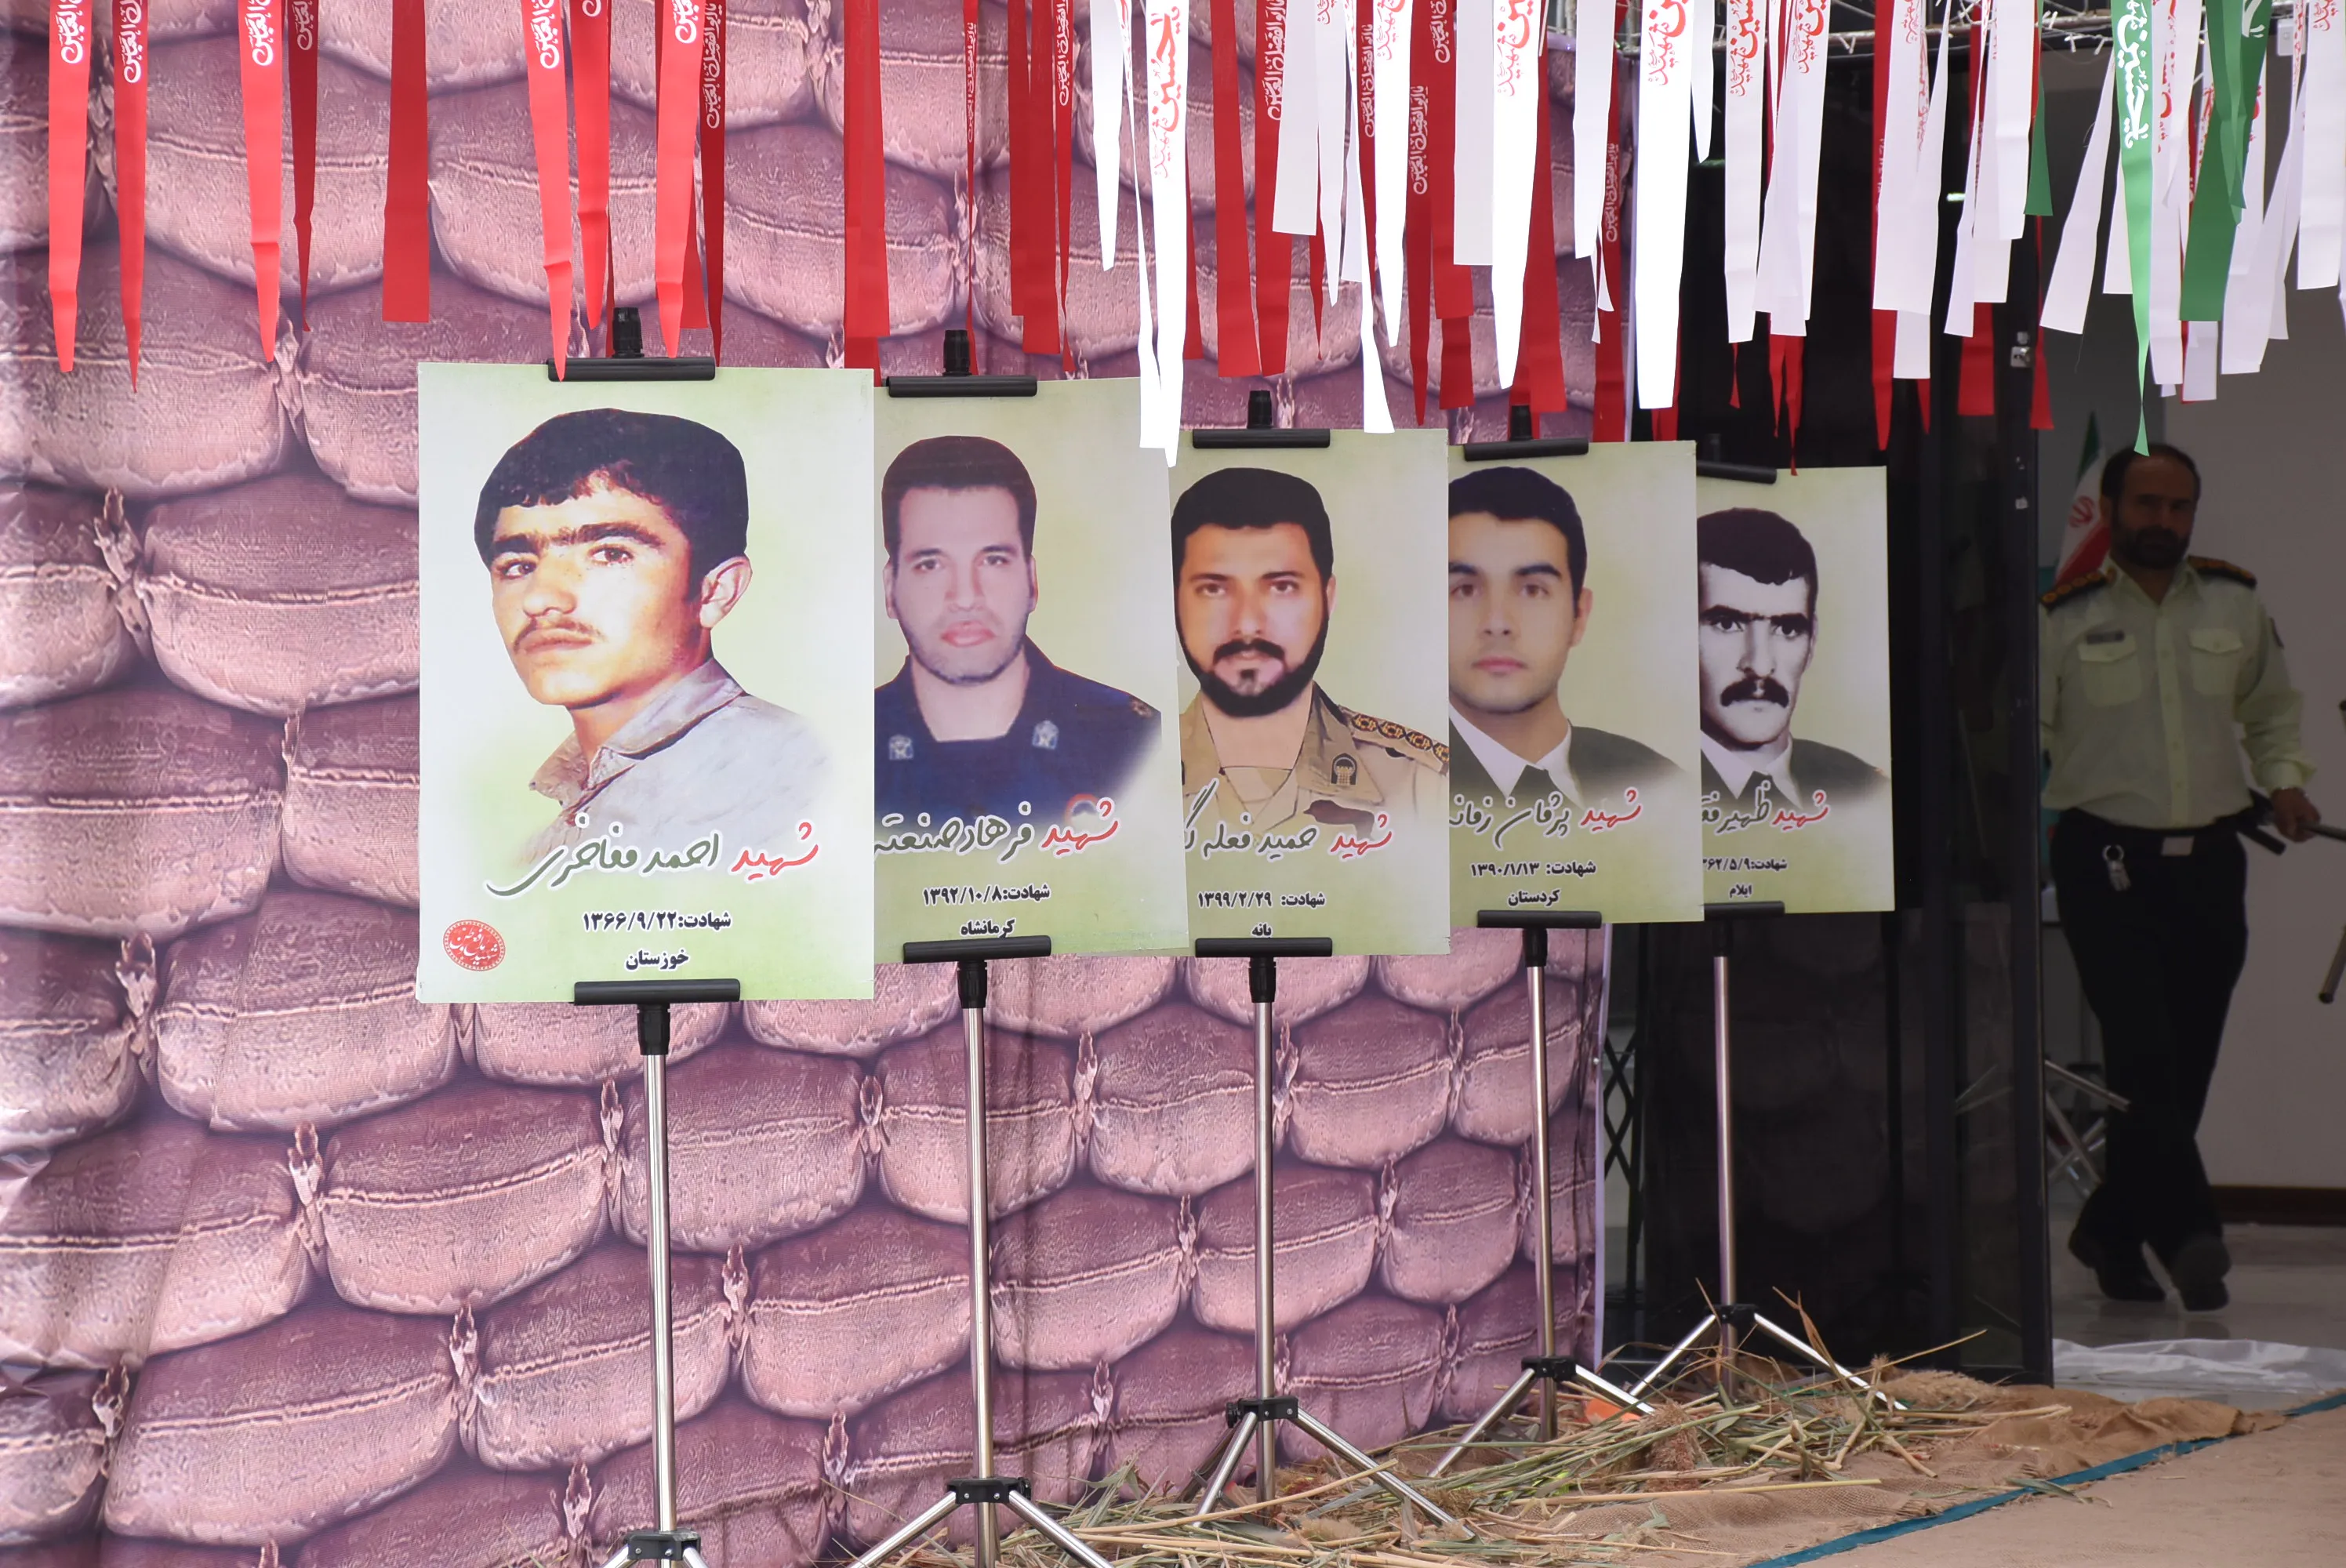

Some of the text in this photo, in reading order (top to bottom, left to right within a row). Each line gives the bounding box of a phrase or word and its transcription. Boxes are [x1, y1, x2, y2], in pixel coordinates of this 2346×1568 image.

[1581, 789, 1642, 831] شهید
[1772, 792, 1828, 830] شهید
[874, 815, 963, 854] صنعت
[959, 803, 1033, 862] فرهاد
[1042, 800, 1119, 856] شهید
[1258, 827, 1317, 860] حمید
[1330, 813, 1393, 859] شهید
[485, 815, 819, 898] شهید احمد مفاخری
[1545, 861, 1596, 878] شهادت:
[1281, 892, 1326, 909] شهادت:
[1508, 889, 1560, 906] کردستان
[1729, 884, 1752, 898] ایلام
[961, 918, 1016, 939] کرمانشاه
[1251, 923, 1273, 940] بانه
[625, 949, 689, 971] خوزستان
